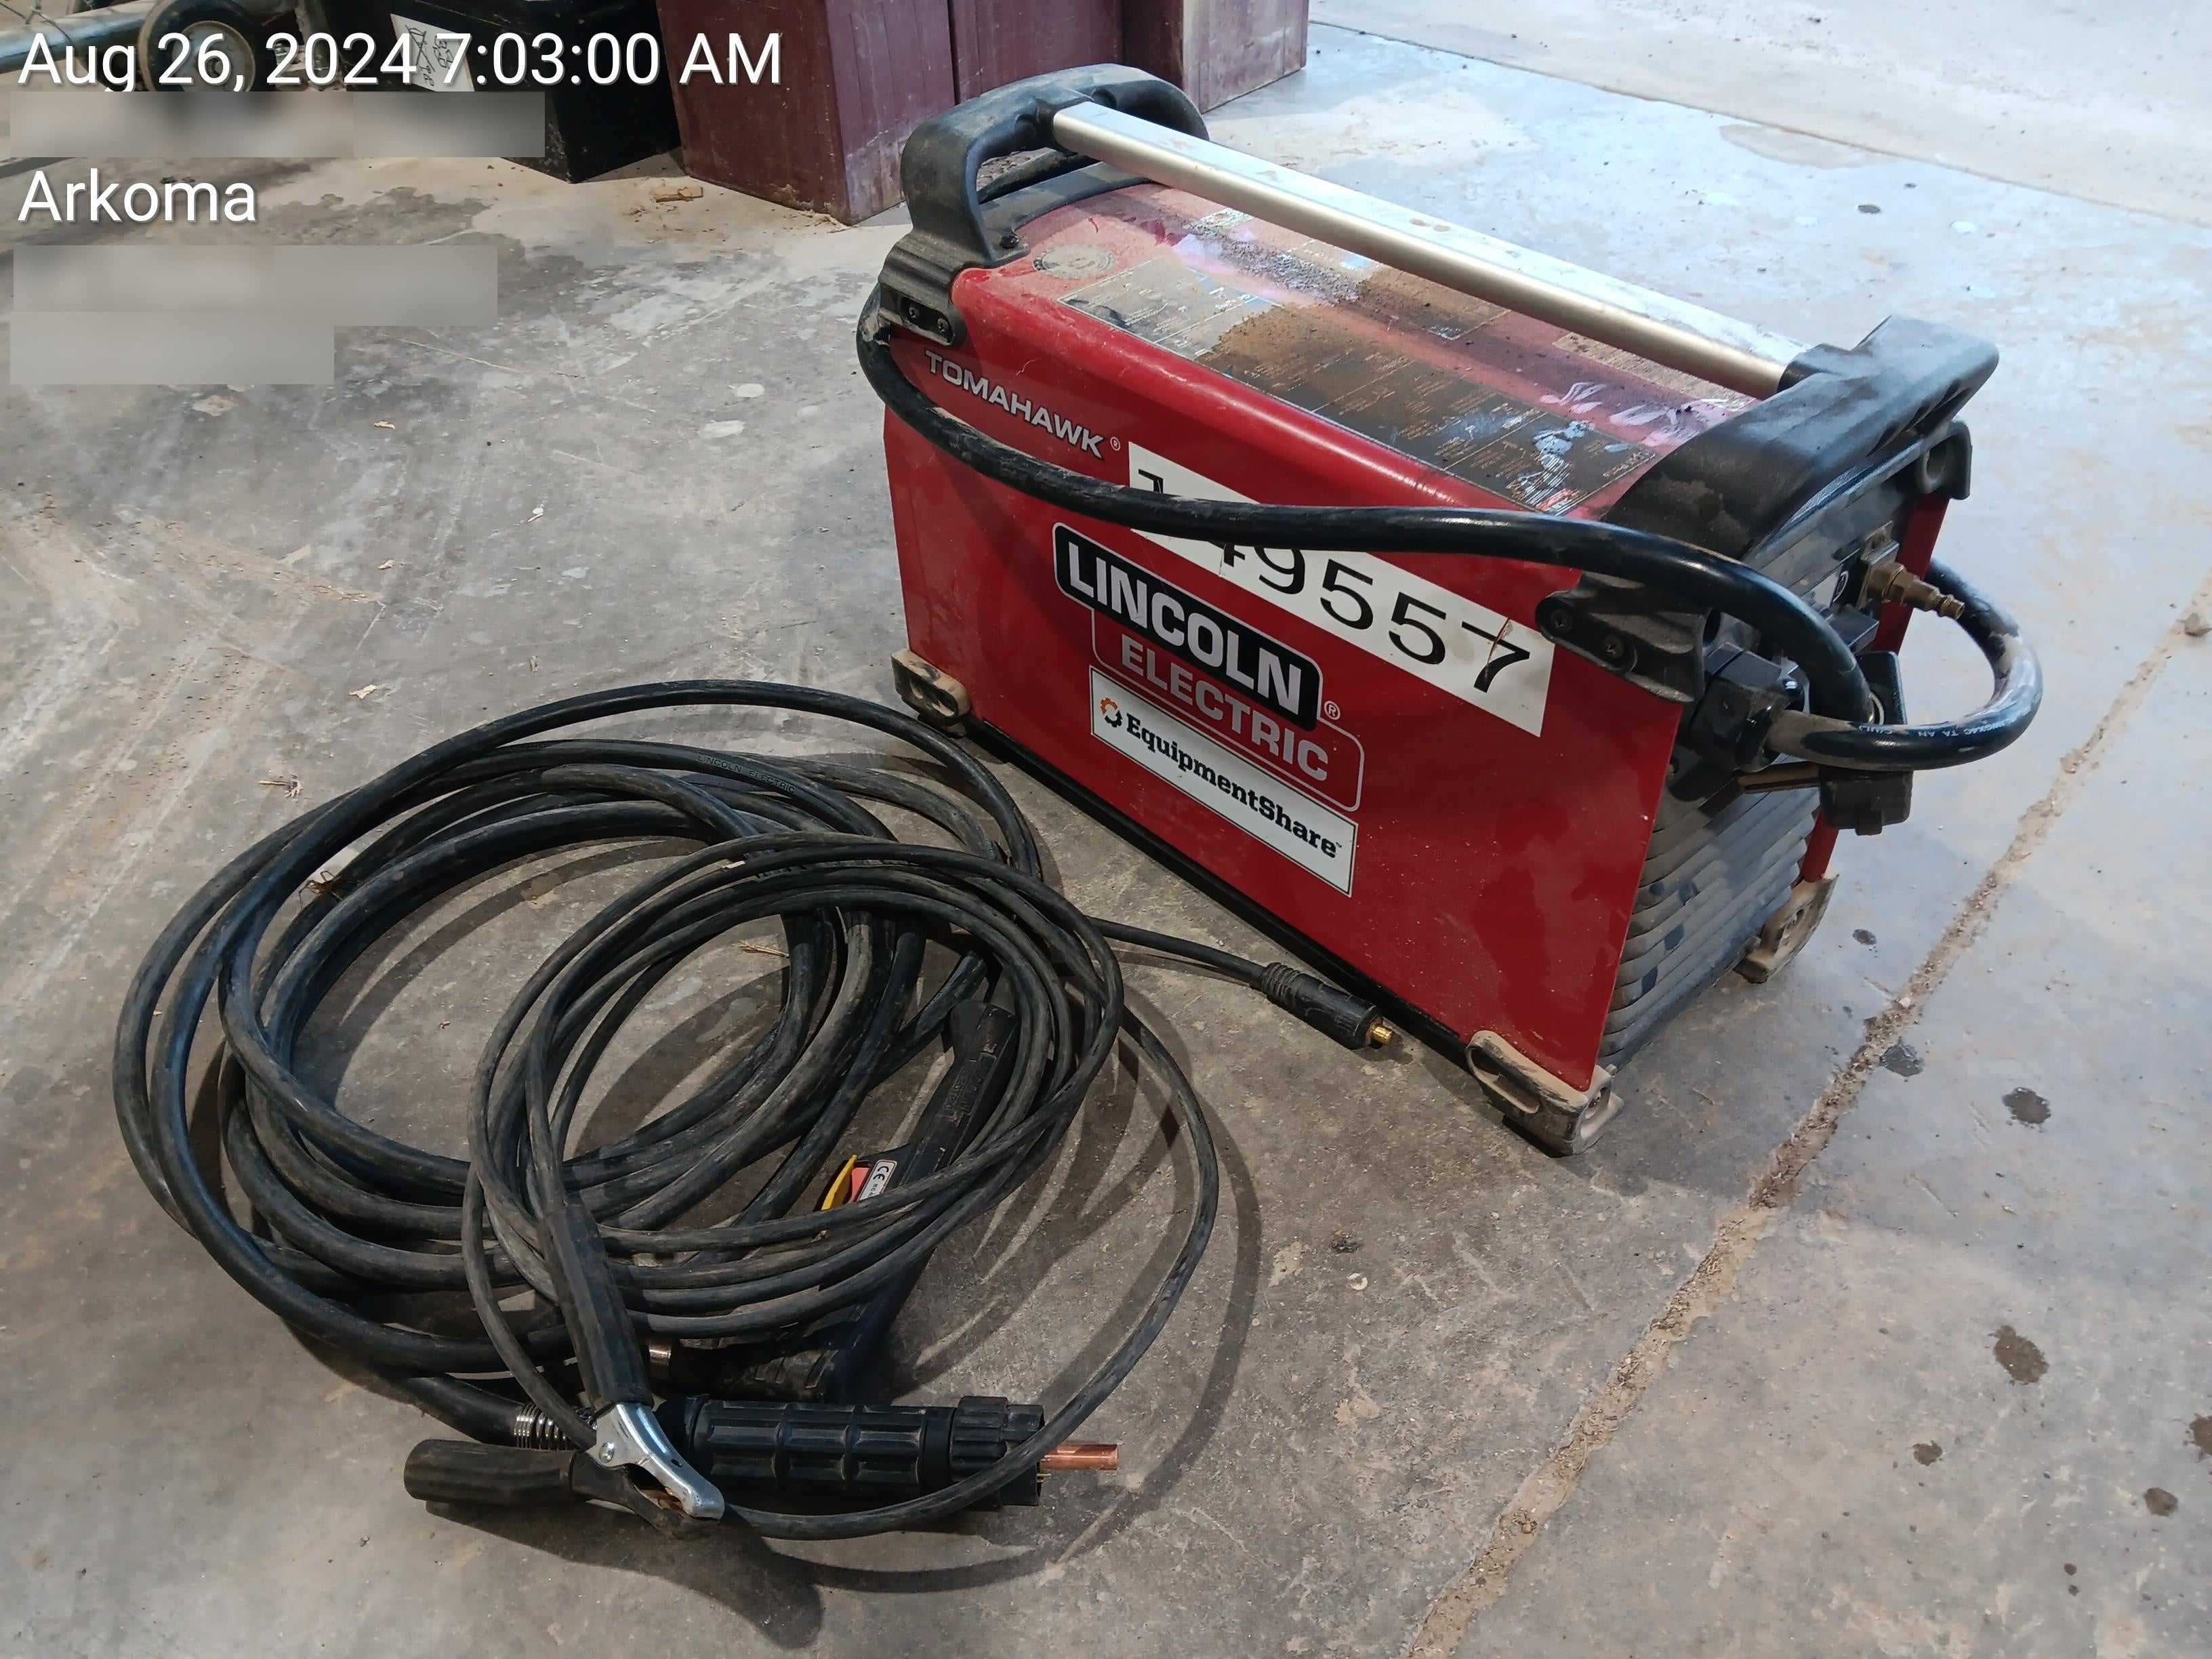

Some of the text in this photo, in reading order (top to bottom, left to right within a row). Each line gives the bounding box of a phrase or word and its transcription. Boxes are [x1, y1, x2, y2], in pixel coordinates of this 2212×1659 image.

[925, 350, 1106, 460] TOMAHAWK
[1068, 541, 1302, 716] LINCOLN
[1122, 634, 1329, 782] ELECTRIC
[697, 754, 796, 794] LINCOLN ELECTRIC
